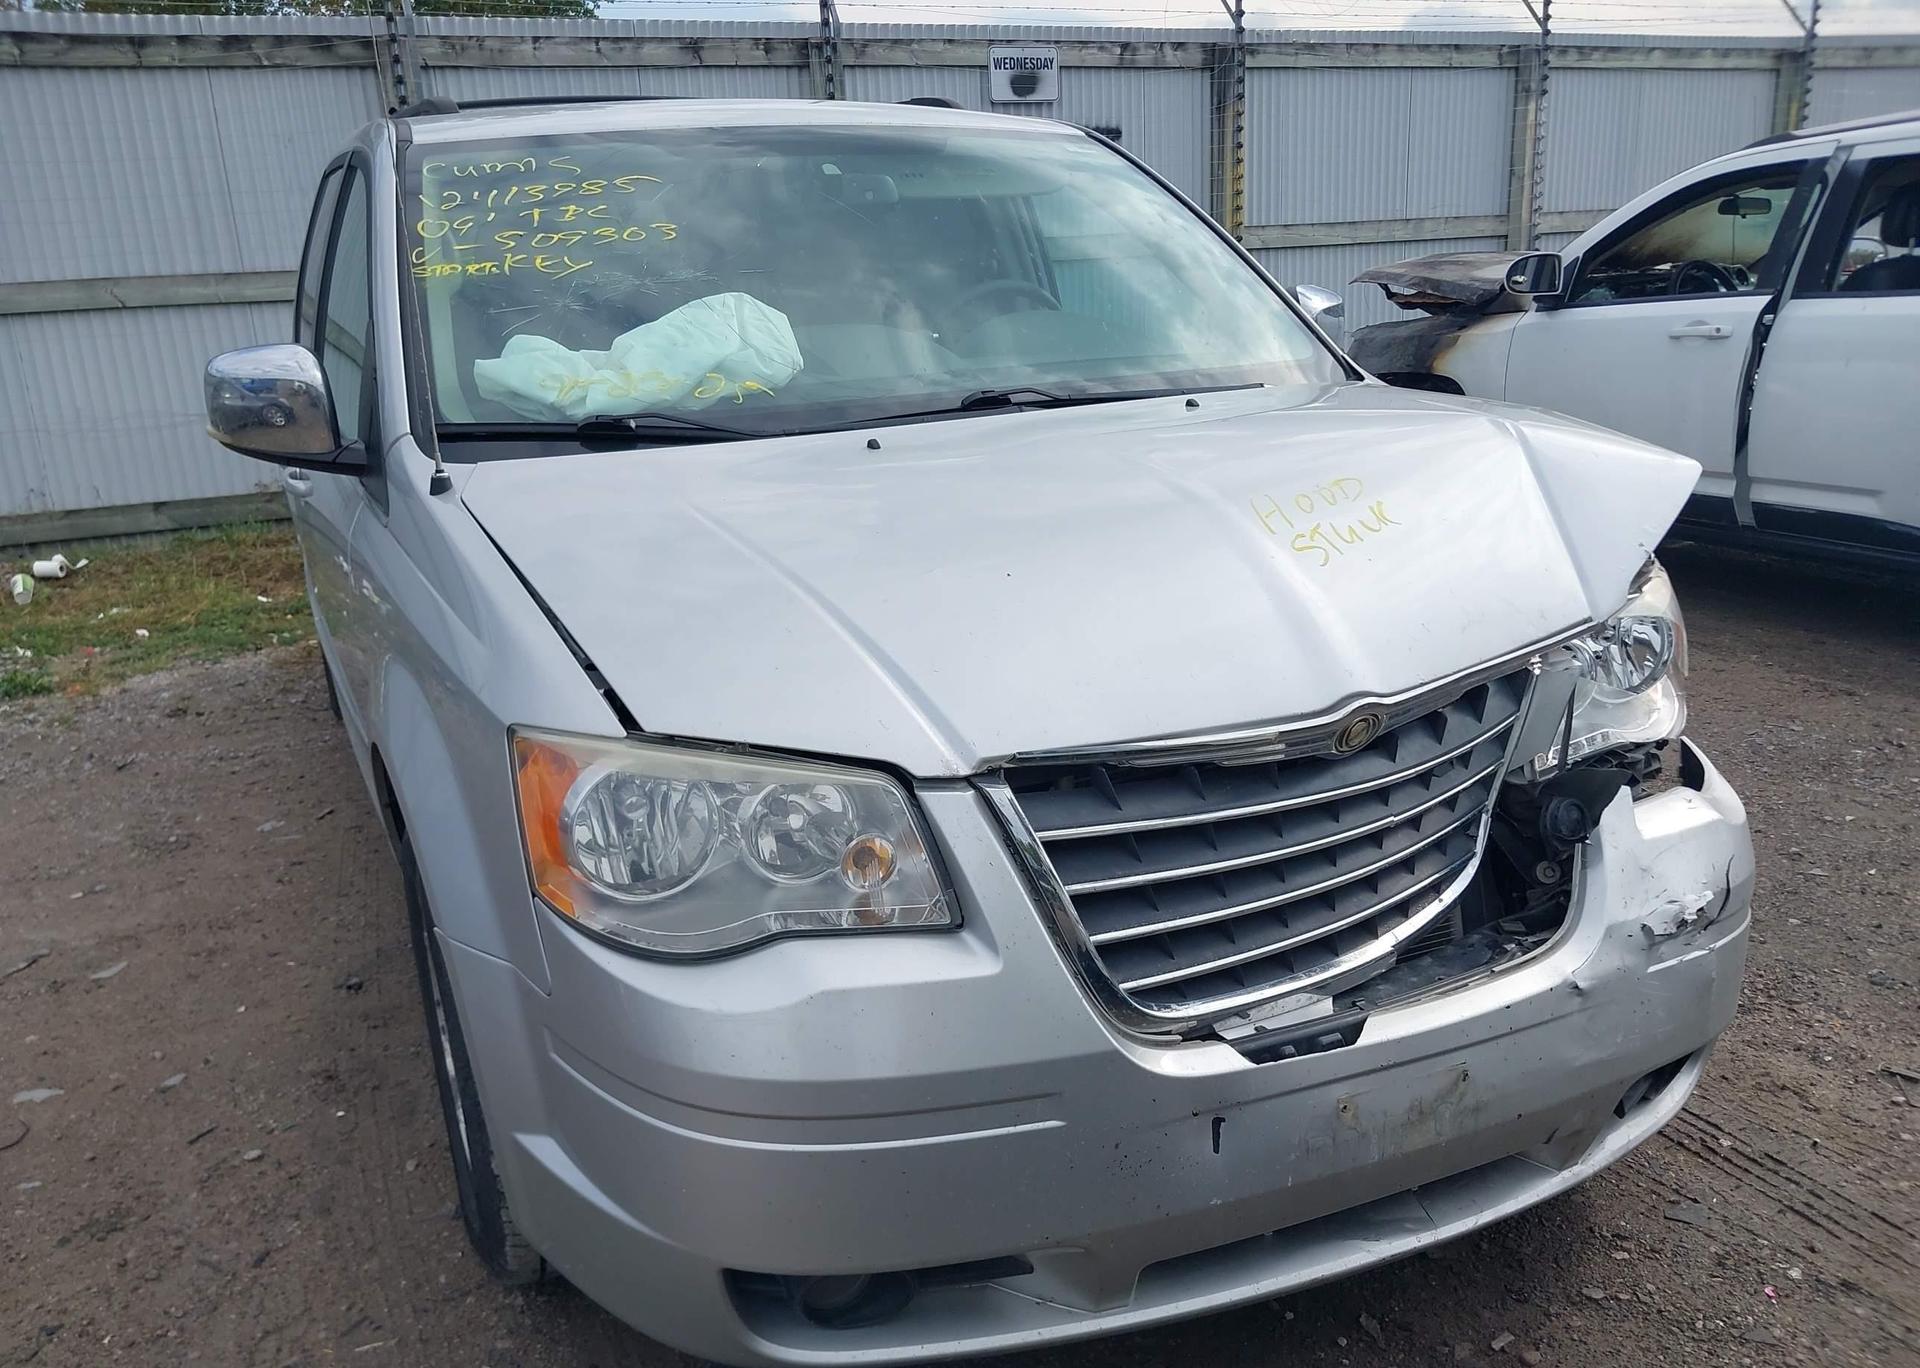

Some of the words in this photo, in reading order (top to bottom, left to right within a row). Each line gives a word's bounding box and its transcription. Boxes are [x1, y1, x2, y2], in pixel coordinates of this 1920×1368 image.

[993, 56, 1055, 71] WEDNESDAY
[494, 222, 679, 250] 509303
[1249, 476, 1365, 536] HOOD
